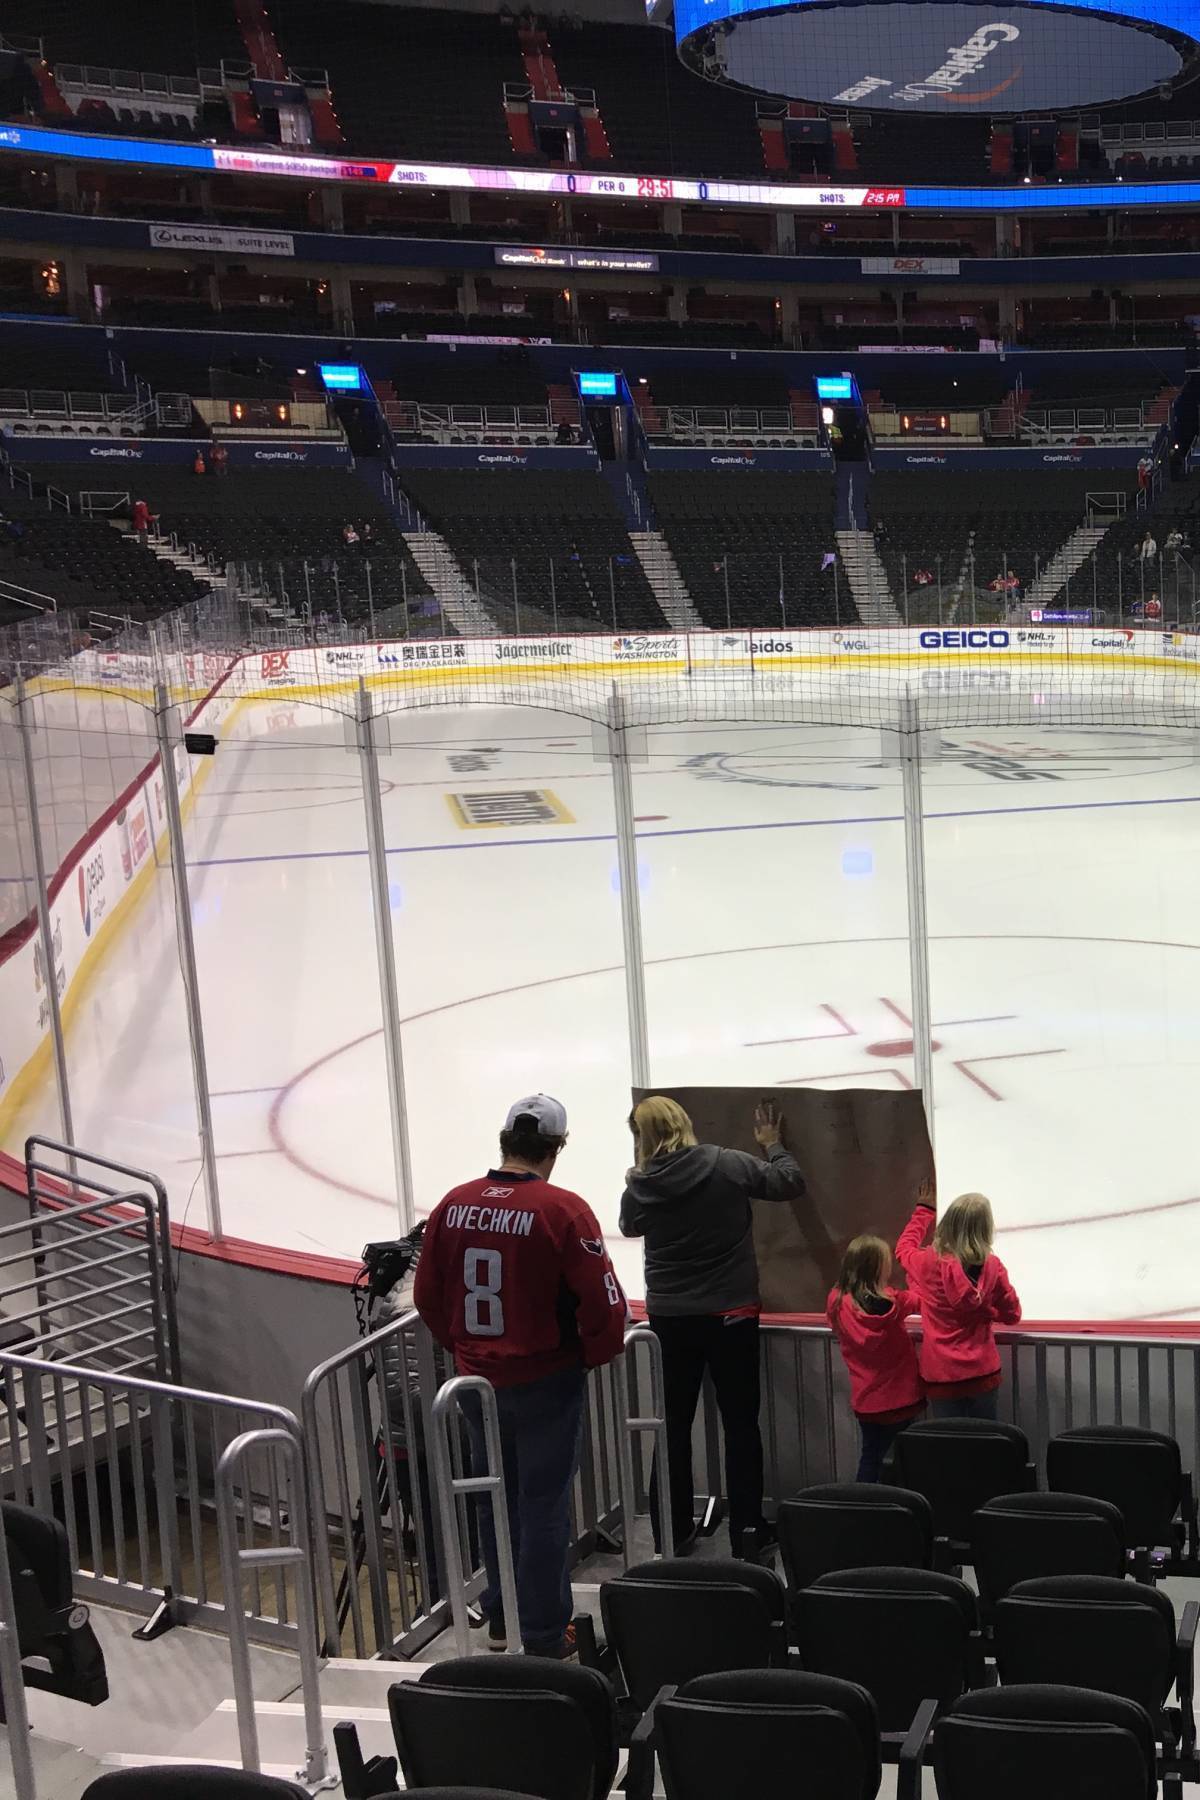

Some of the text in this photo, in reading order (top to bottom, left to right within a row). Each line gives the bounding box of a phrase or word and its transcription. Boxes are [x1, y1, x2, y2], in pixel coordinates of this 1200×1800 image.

[398, 171, 427, 182] SHOTS:
[598, 181, 615, 191] PER
[638, 178, 673, 197] 29:51
[174, 234, 222, 244] LEXUS
[238, 238, 262, 247] SUITE
[894, 260, 923, 269] DEX
[631, 636, 682, 651] Sports
[843, 640, 870, 650] WGL
[920, 630, 1009, 648] GEICO
[744, 639, 793, 654] leidos
[614, 650, 678, 660] WASHINGTON
[446, 1204, 535, 1237] OVECHKIN
[463, 1247, 504, 1336] 8
[603, 1271, 620, 1306] 8
